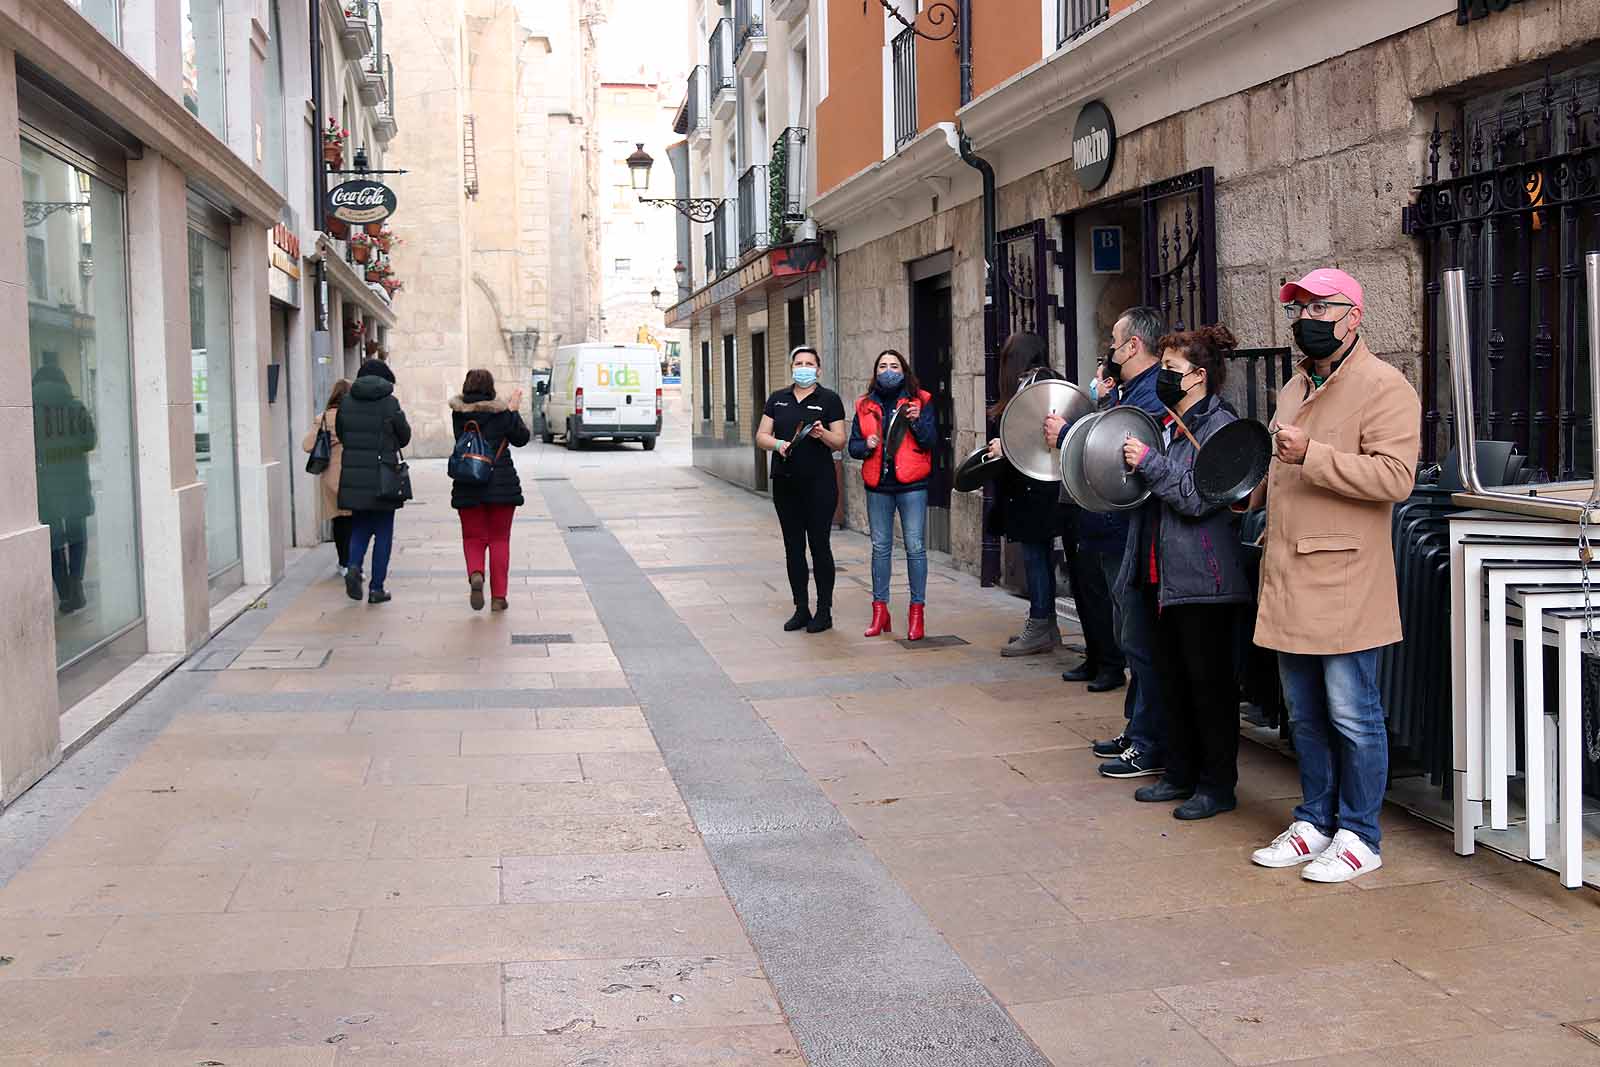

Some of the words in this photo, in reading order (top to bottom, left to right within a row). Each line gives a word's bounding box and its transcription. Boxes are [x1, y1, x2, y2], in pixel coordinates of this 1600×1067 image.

[331, 186, 385, 206] Coca-Cola
[1102, 231, 1113, 248] B
[596, 362, 640, 386] bida
